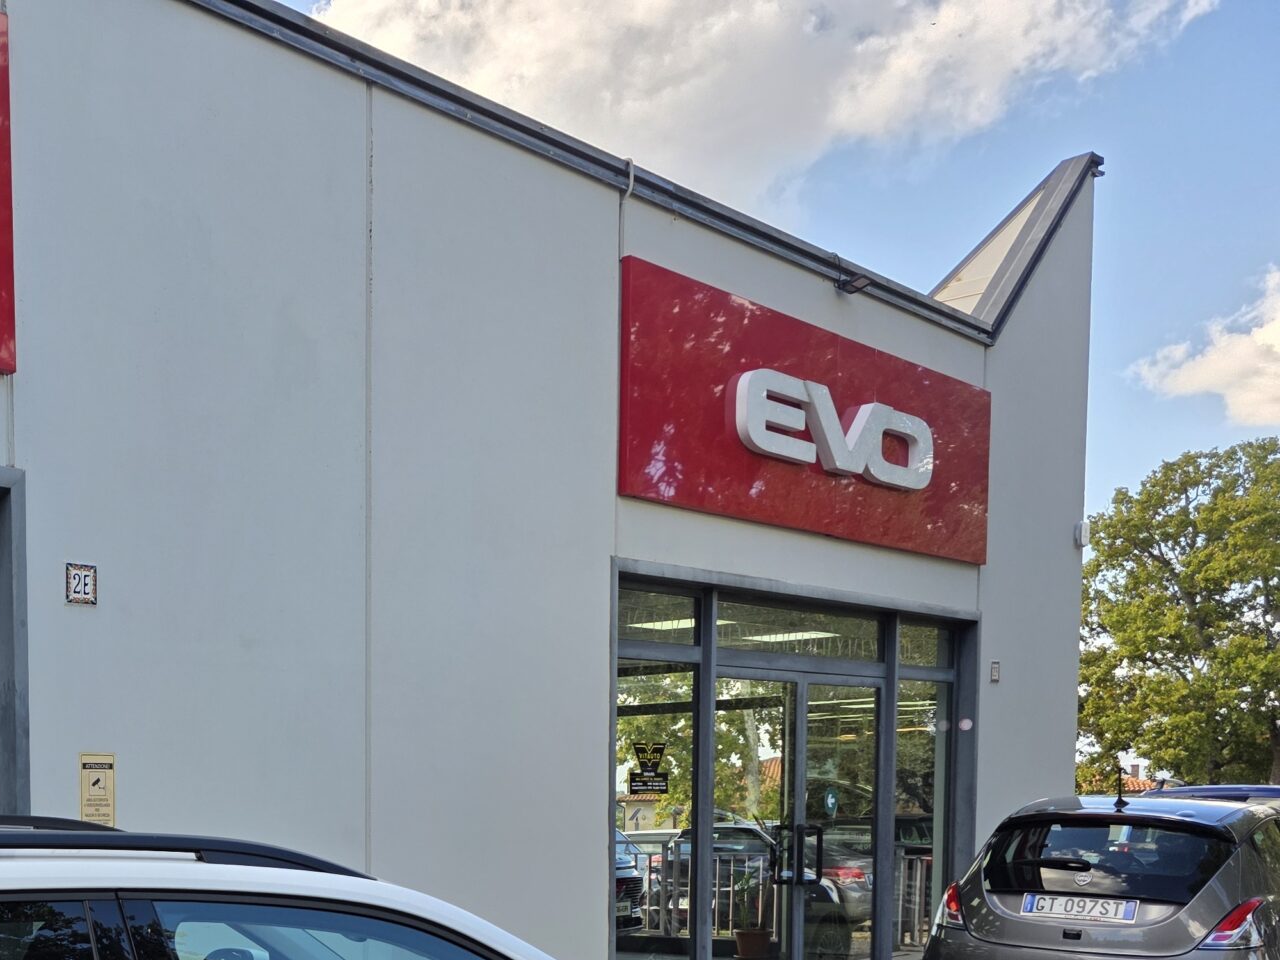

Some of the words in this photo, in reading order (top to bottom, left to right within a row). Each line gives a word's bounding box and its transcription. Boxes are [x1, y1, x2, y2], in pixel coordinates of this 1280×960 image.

[734, 367, 934, 491] EVO
[72, 572, 91, 595] 2E
[1036, 896, 1059, 912] GT
[1063, 898, 1124, 917] 097ST
